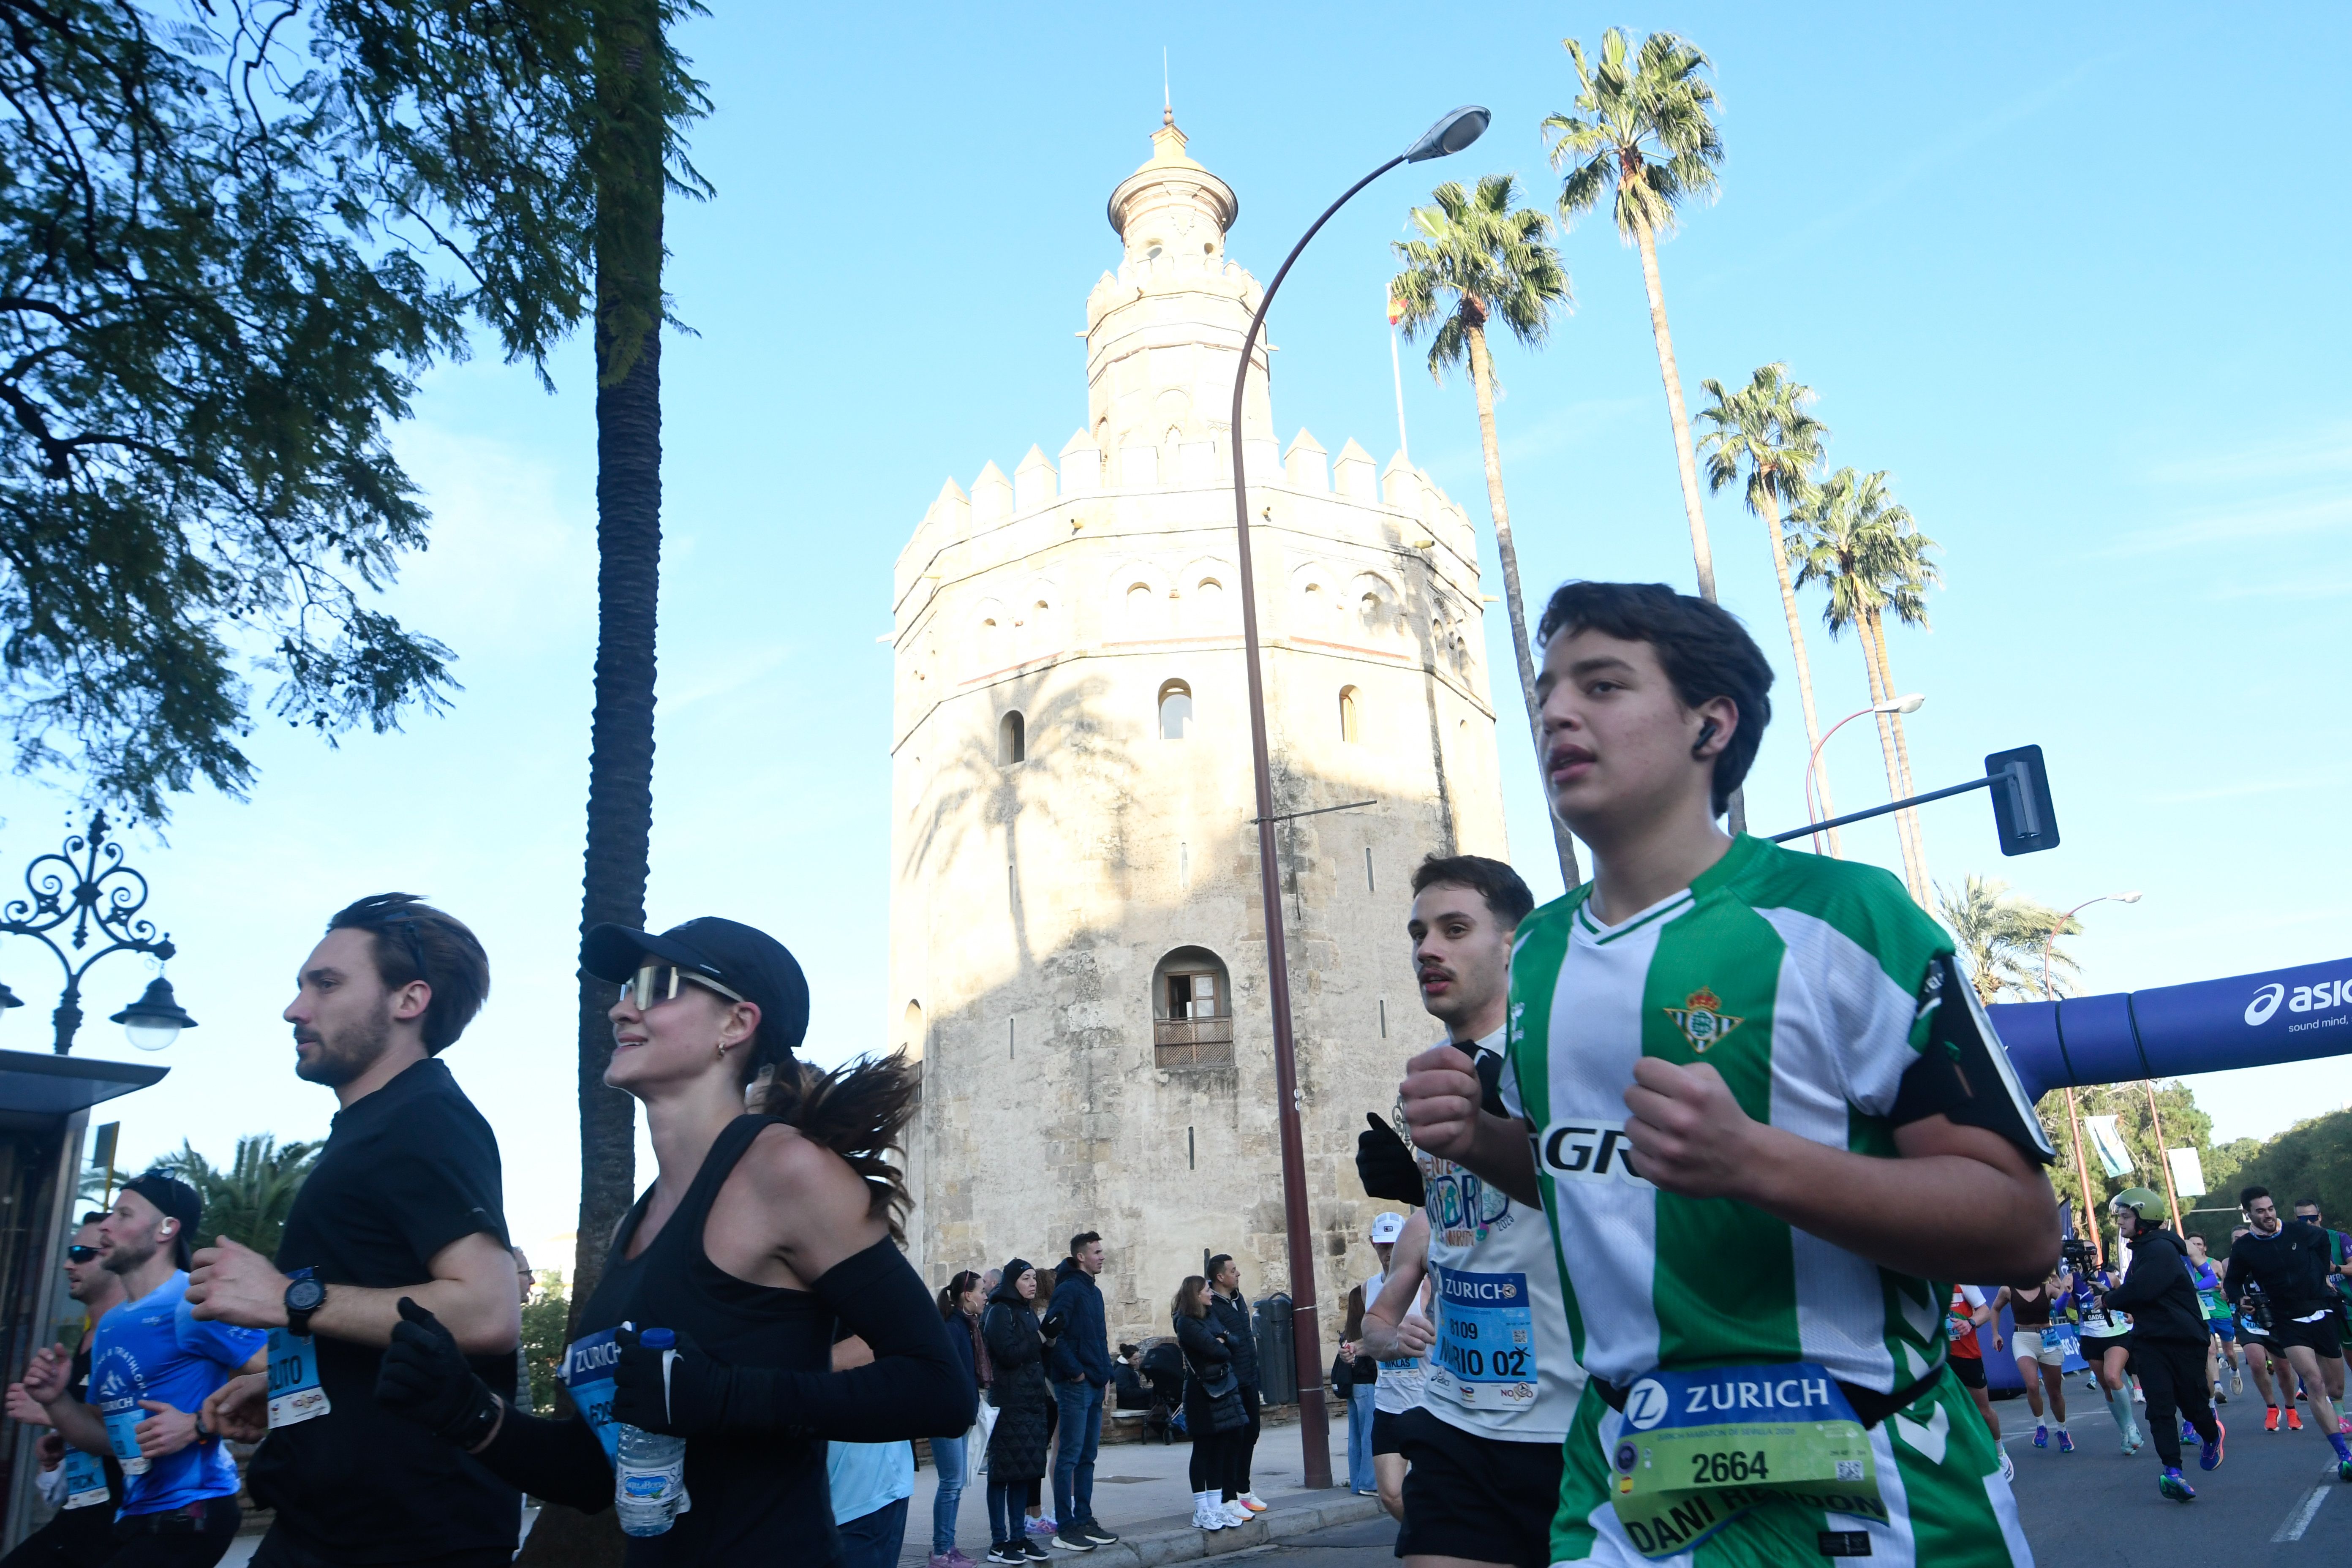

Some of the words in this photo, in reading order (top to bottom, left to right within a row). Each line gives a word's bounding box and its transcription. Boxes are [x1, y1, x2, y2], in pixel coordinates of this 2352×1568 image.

[2289, 1019, 2319, 1032] sound
[2322, 1015, 2349, 1028] mind,
[1495, 1213, 1515, 1231] 2025
[1446, 1278, 1509, 1300] ZURICH
[576, 1342, 622, 1373] ZURICH
[1385, 1358, 1410, 1367] NIKLAS
[1439, 1336, 1484, 1376] MARIO
[101, 1396, 134, 1412] URICH
[1685, 1378, 1830, 1413] ZURICH
[1691, 1450, 1769, 1484] 2664
[1624, 1495, 1715, 1553] DANI
